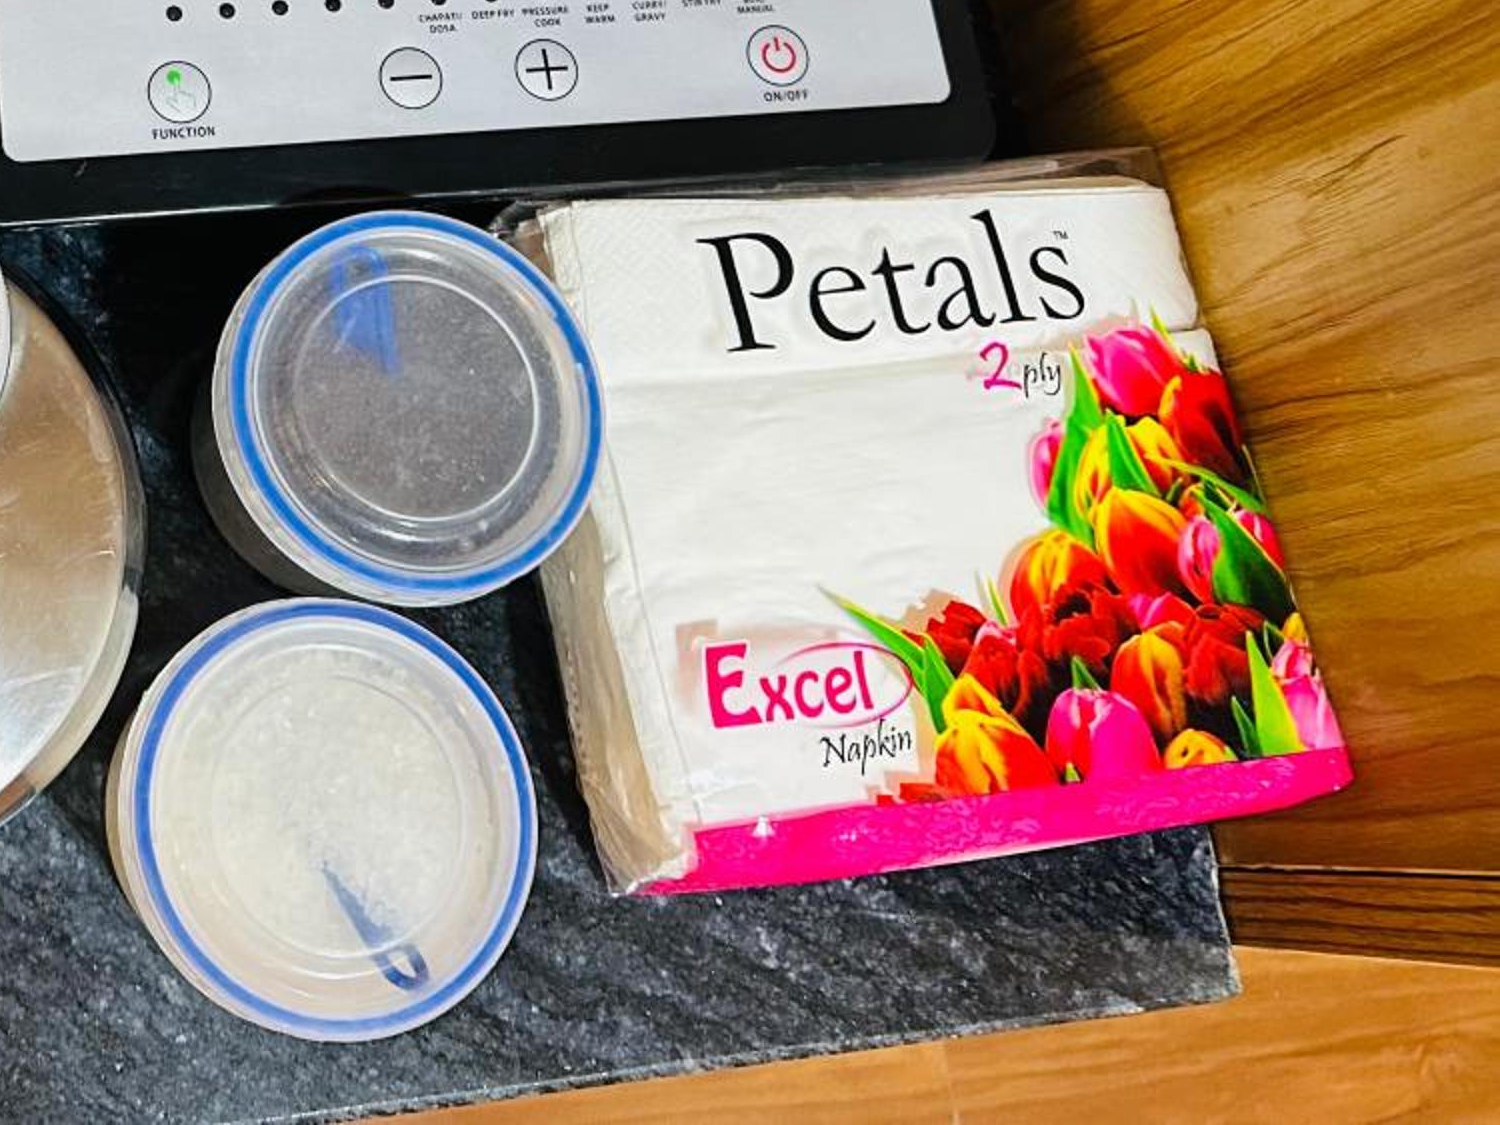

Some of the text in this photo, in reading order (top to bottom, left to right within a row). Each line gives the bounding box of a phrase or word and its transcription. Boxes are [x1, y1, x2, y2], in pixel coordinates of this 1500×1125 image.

[521, 5, 568, 16] PRESSURE
[586, 3, 609, 13] KEEP
[737, 4, 775, 14] MANUAL
[471, 10, 496, 20] DEEP
[585, 15, 615, 24] WARM
[634, 13, 666, 22] GRAVY
[533, 18, 561, 27] COOK
[429, 24, 456, 34] DOSA
[763, 89, 808, 102] ON/OFF
[152, 126, 216, 140] FUNCTION
[696, 209, 1086, 353] Petals
[978, 342, 1062, 398] 2 ply
[705, 643, 875, 729] Excel
[820, 718, 913, 776] Napkin
